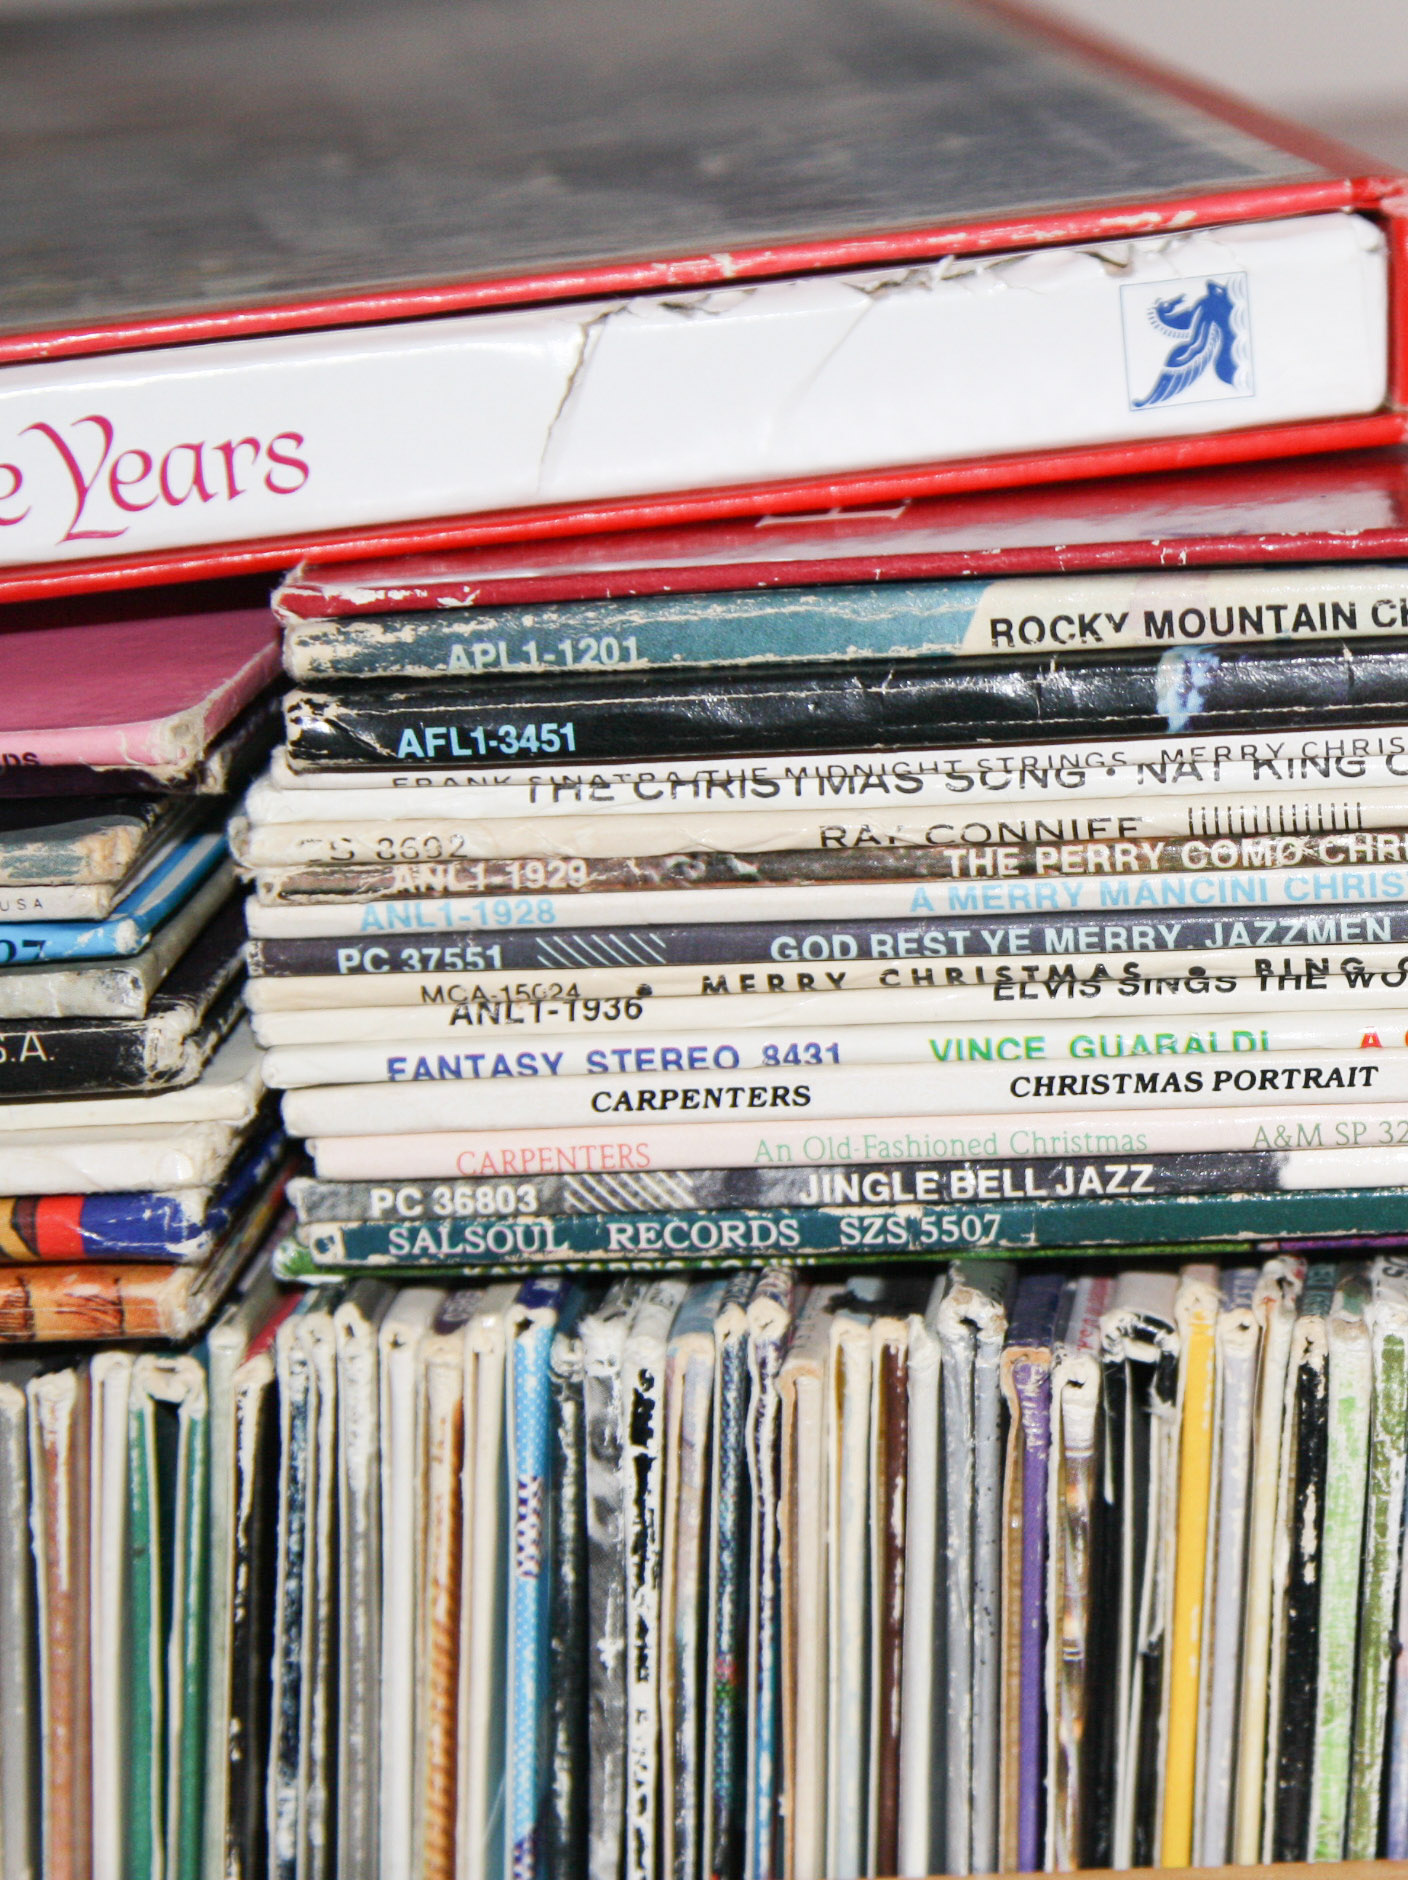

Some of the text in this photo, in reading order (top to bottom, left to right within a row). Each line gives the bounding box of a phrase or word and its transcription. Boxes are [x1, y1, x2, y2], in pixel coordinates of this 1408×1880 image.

[18, 415, 310, 545] Years
[990, 612, 1129, 647] ROCKY
[1144, 601, 1357, 638] MOUNTAIN
[449, 636, 638, 671] APL1-1201
[397, 722, 577, 758] AFL1-3451
[785, 760, 962, 778] MIDNIGHT
[977, 751, 1128, 770] STRINGS
[1161, 741, 1285, 763] MERRY
[633, 771, 924, 801] CHRISTMAS
[945, 767, 1086, 793] SONG
[1137, 759, 1221, 785] NAT
[1253, 755, 1366, 781] KING
[925, 816, 1143, 846] CONNIFF
[944, 846, 1020, 878] THE
[1036, 840, 1165, 875] PERRY
[1181, 837, 1311, 870] COMO
[360, 898, 556, 932] ANL1-1928
[910, 885, 935, 913] A
[949, 881, 1083, 911] MERRY
[1100, 876, 1267, 906] MANCINI
[336, 946, 391, 975] PC
[399, 944, 503, 973] 37551
[770, 933, 859, 961] GOD
[870, 929, 971, 959] REST
[981, 926, 1033, 956] YE
[1205, 916, 1392, 948] JAZZMEN
[701, 971, 847, 995] MERRY
[879, 962, 1142, 986] CHRISTMAS
[1254, 956, 1365, 977] BING
[449, 997, 644, 1026] ANL1-1936
[993, 979, 1102, 1002] ELVIS
[1117, 976, 1238, 998] SINGS
[1260, 973, 1328, 991] THE
[387, 1051, 564, 1081] FANTASY
[586, 1045, 741, 1075] STEREO
[762, 1042, 842, 1068] 8431
[929, 1036, 1047, 1061] VINCE
[1069, 1029, 1270, 1057] GUARALDI
[1359, 1025, 1384, 1048] A
[591, 1084, 811, 1112] CARPENTERS
[1010, 1070, 1204, 1098] CHRISTMAS
[1212, 1065, 1379, 1092] PORTRAIT
[456, 1142, 651, 1177] CARPENTERS
[753, 1138, 793, 1163] An
[803, 1131, 999, 1161] Old-Fashioned
[1009, 1128, 1148, 1156] Christmas
[1251, 1121, 1324, 1150] A&M
[1336, 1120, 1368, 1146] SP
[370, 1163, 1156, 1218] PC 36803 JINGLE BELL JAZZ
[388, 1222, 571, 1256] SALSOUL
[606, 1217, 800, 1251] RECORDS
[839, 1215, 908, 1247] SZS
[920, 1212, 1002, 1245] 5507
